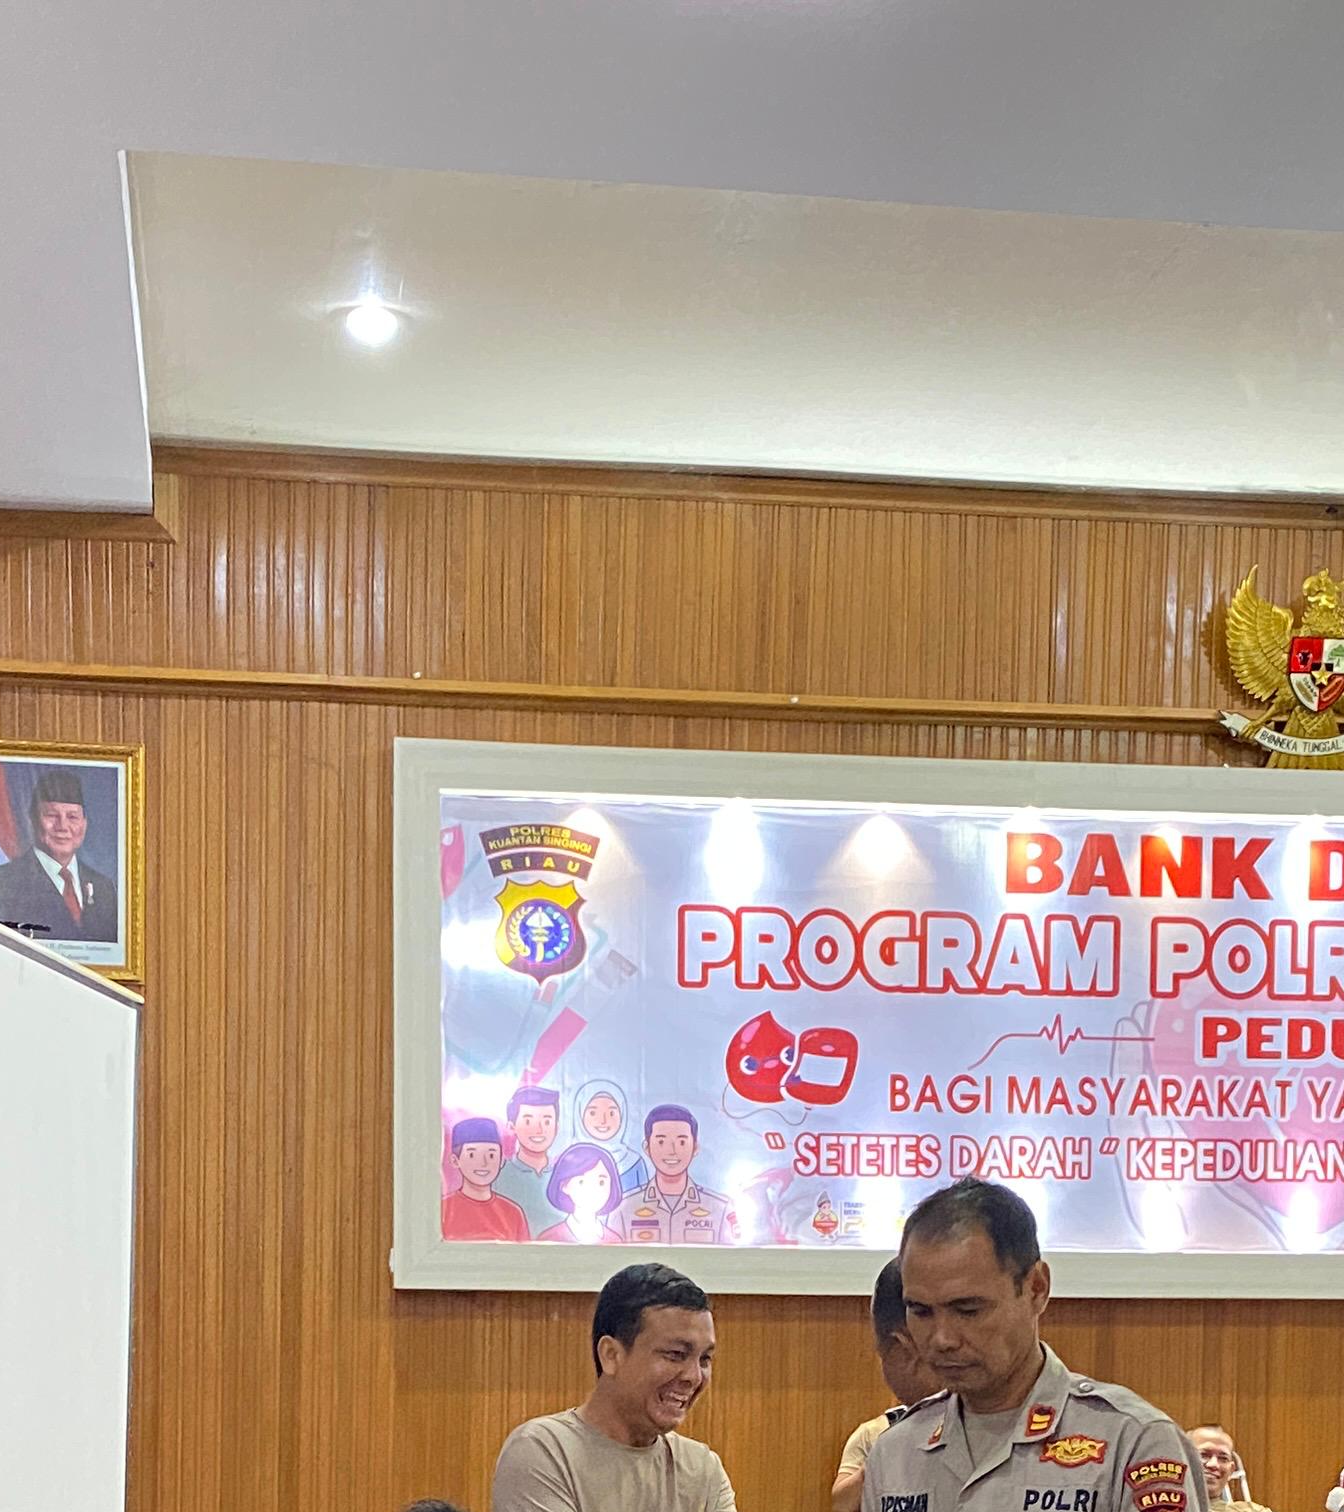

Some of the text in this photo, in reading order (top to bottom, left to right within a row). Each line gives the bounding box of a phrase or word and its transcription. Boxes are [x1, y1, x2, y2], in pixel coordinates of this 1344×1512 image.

[1303, 740, 1343, 753] TUNGGAL
[510, 826, 572, 838] POLRES
[488, 836, 541, 850] KUANTAN
[500, 856, 580, 873] RIAU
[1005, 833, 1274, 901] BANK
[676, 905, 1121, 998] PROGRAM
[890, 1074, 992, 1114] BAGI
[1008, 1074, 1293, 1118] MASYARAKAT
[1141, 1492, 1181, 1506] RIAU
